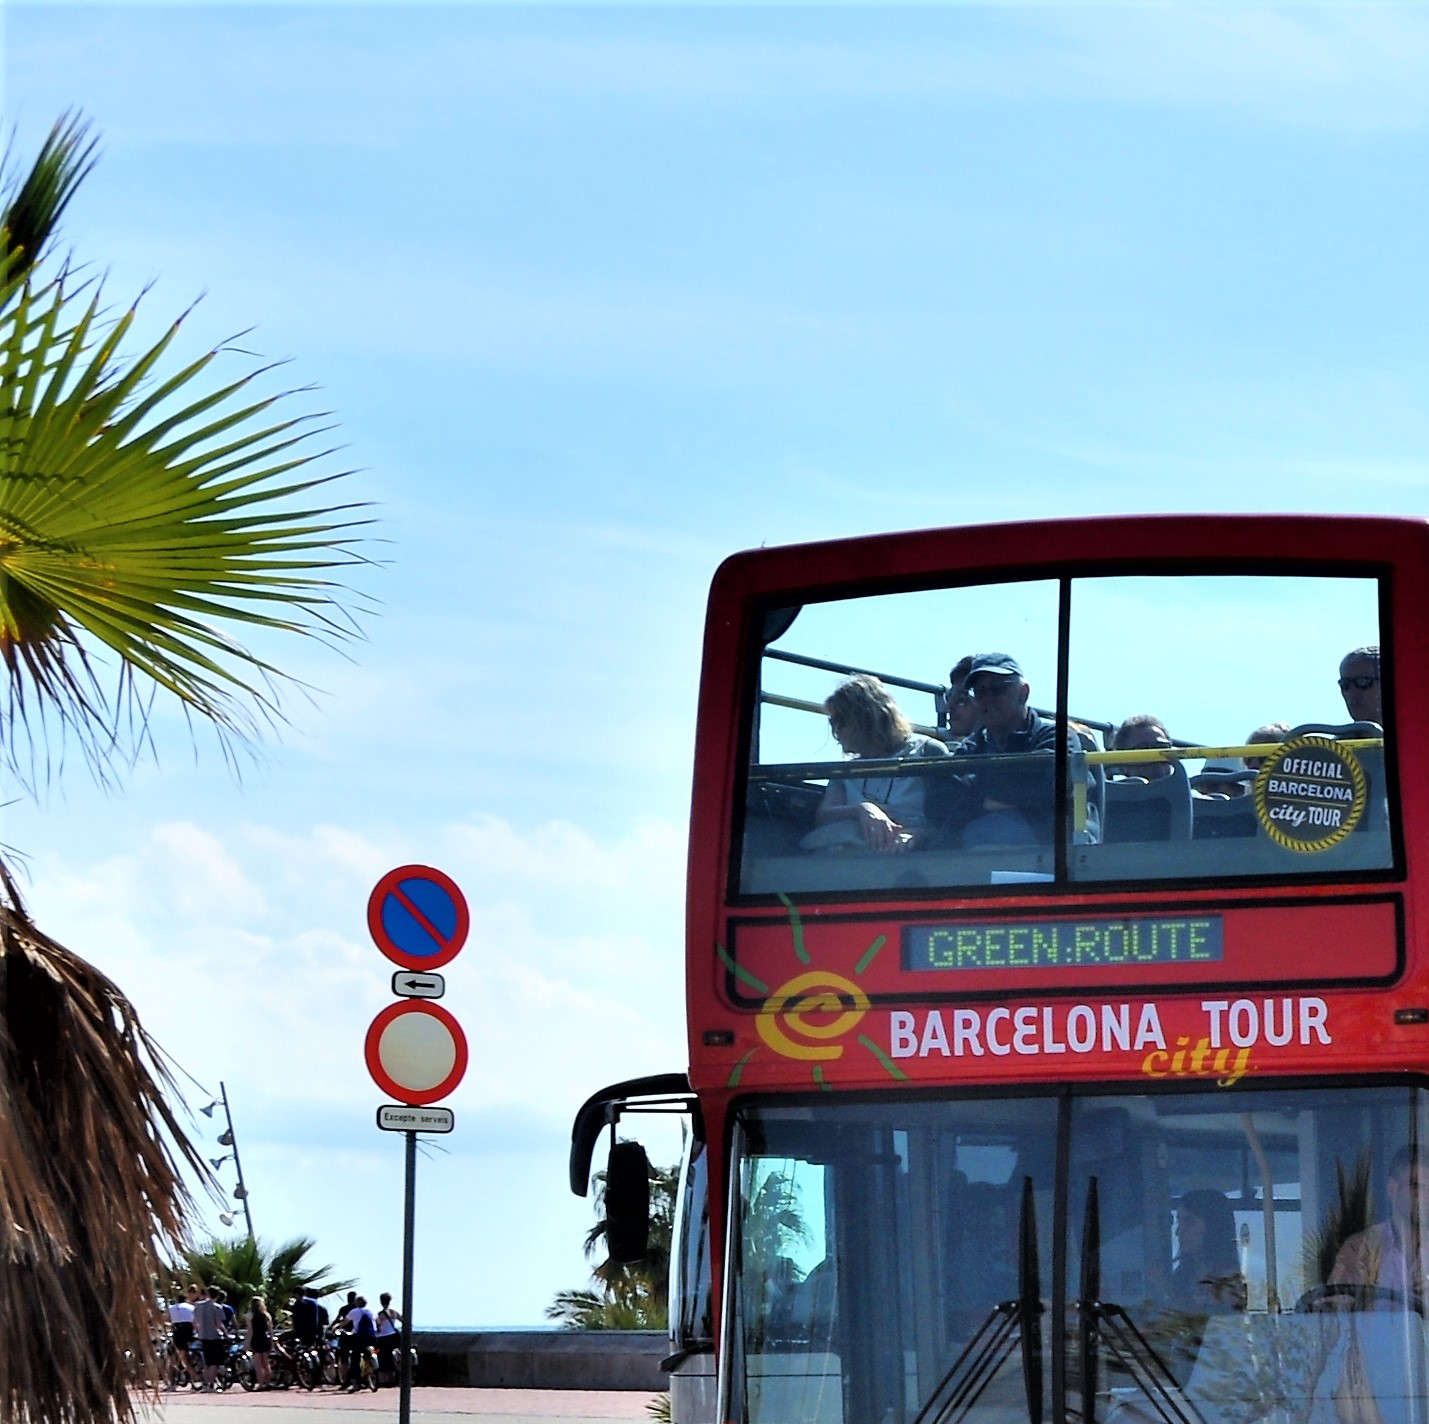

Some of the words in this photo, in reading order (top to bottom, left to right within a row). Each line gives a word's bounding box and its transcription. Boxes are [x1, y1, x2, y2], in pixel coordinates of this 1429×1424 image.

[1283, 757, 1343, 779] OFFICIAL
[1268, 780, 1353, 801] BARCELONA
[1269, 804, 1307, 827] city
[1308, 806, 1341, 827] TOUR
[889, 1003, 1167, 1058] BARCELONA
[1201, 997, 1332, 1050] TOUR
[1141, 1035, 1252, 1087] city
